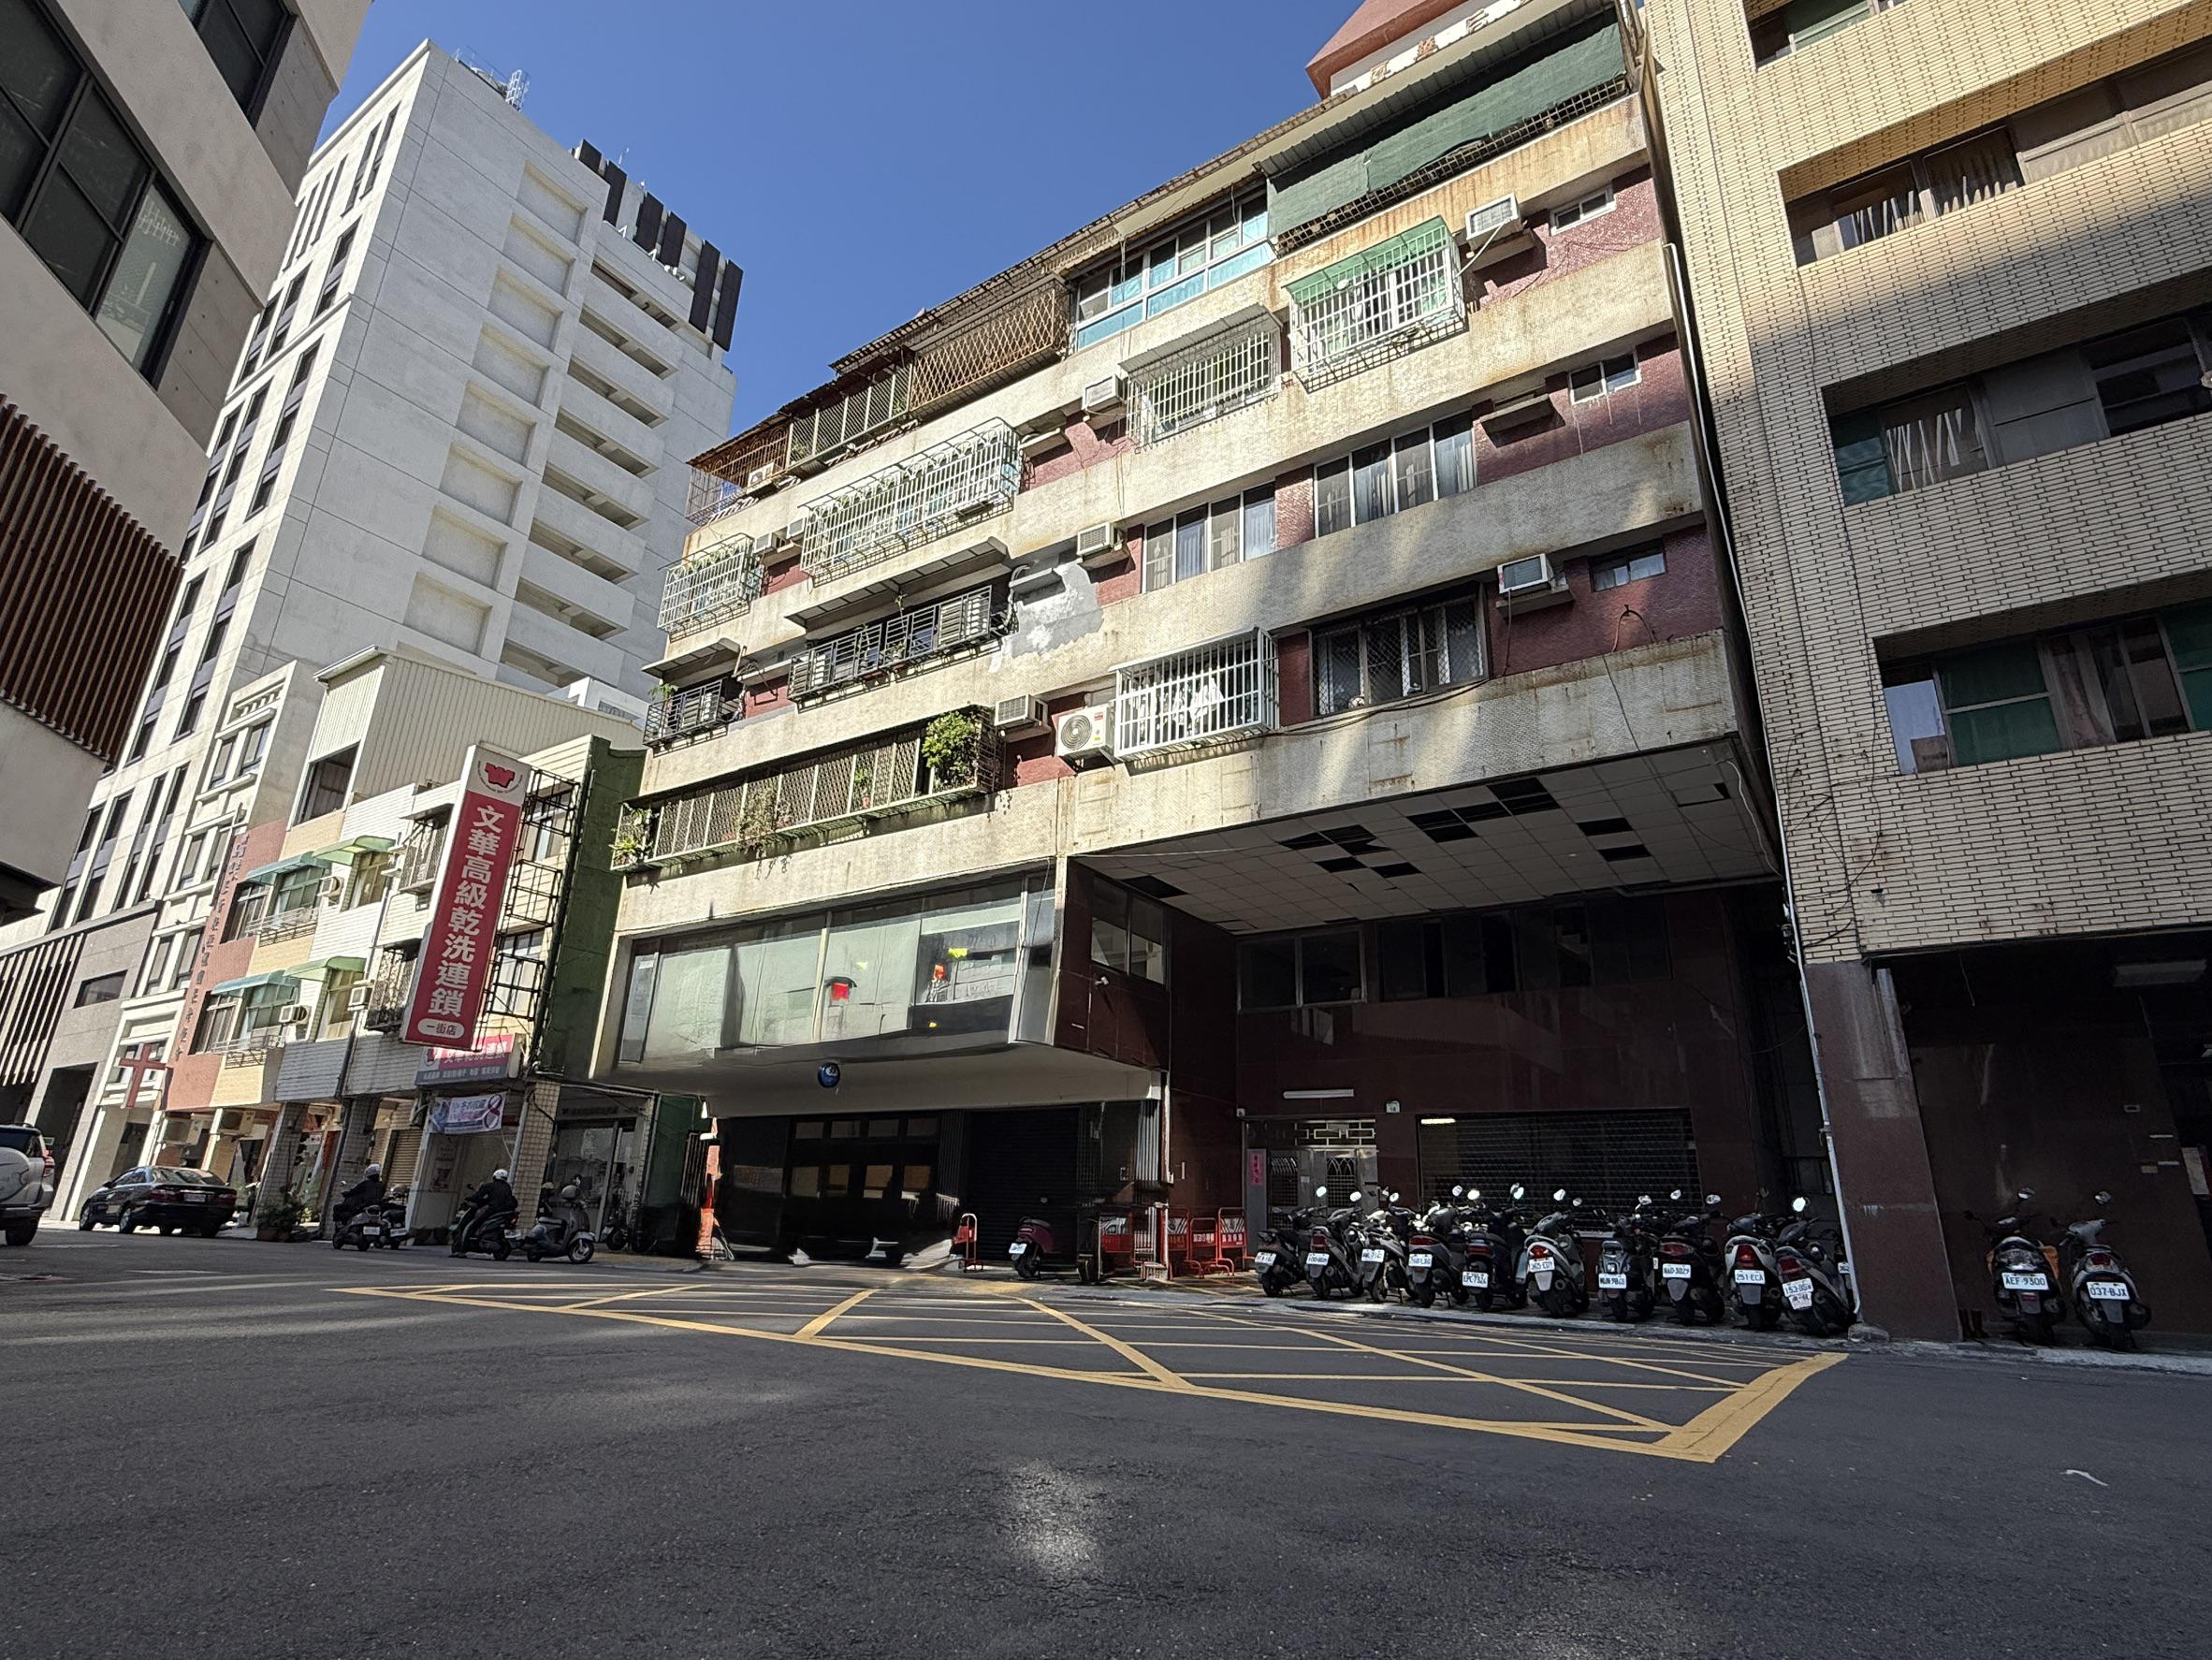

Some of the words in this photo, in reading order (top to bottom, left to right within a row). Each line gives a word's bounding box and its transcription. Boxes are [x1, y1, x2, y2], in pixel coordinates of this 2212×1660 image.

[428, 805, 504, 1018] 文華高級乾洗連鎖
[427, 1023, 458, 1036] 一街店
[2005, 1275, 2045, 1286] AEF-9300
[2089, 1287, 2127, 1297] 037-BJX
